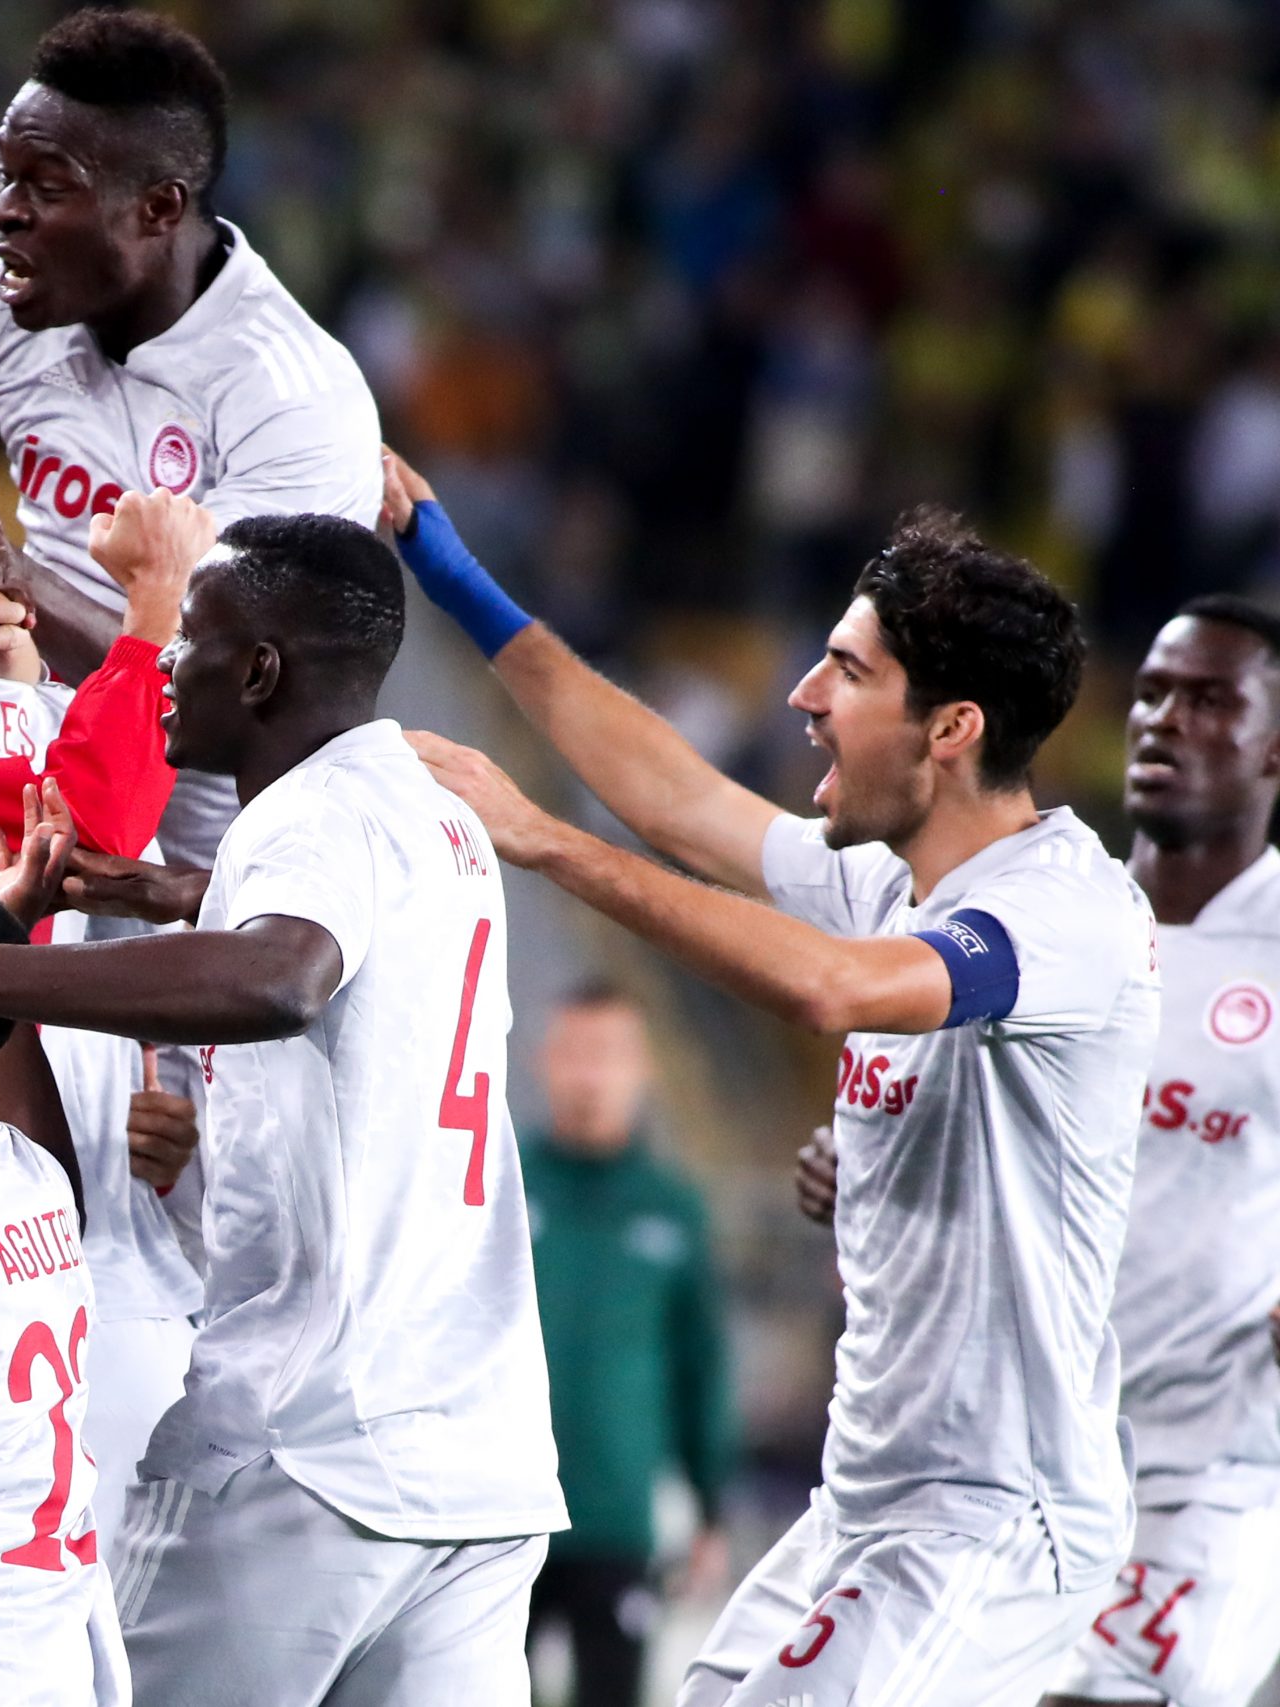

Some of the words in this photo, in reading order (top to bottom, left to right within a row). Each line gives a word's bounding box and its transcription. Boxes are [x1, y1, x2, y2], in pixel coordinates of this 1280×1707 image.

[438, 918, 491, 1206] 4
[1142, 1079, 1250, 1144] s.gr
[778, 1587, 862, 1669] 5
[1091, 1561, 1198, 1677] 24
